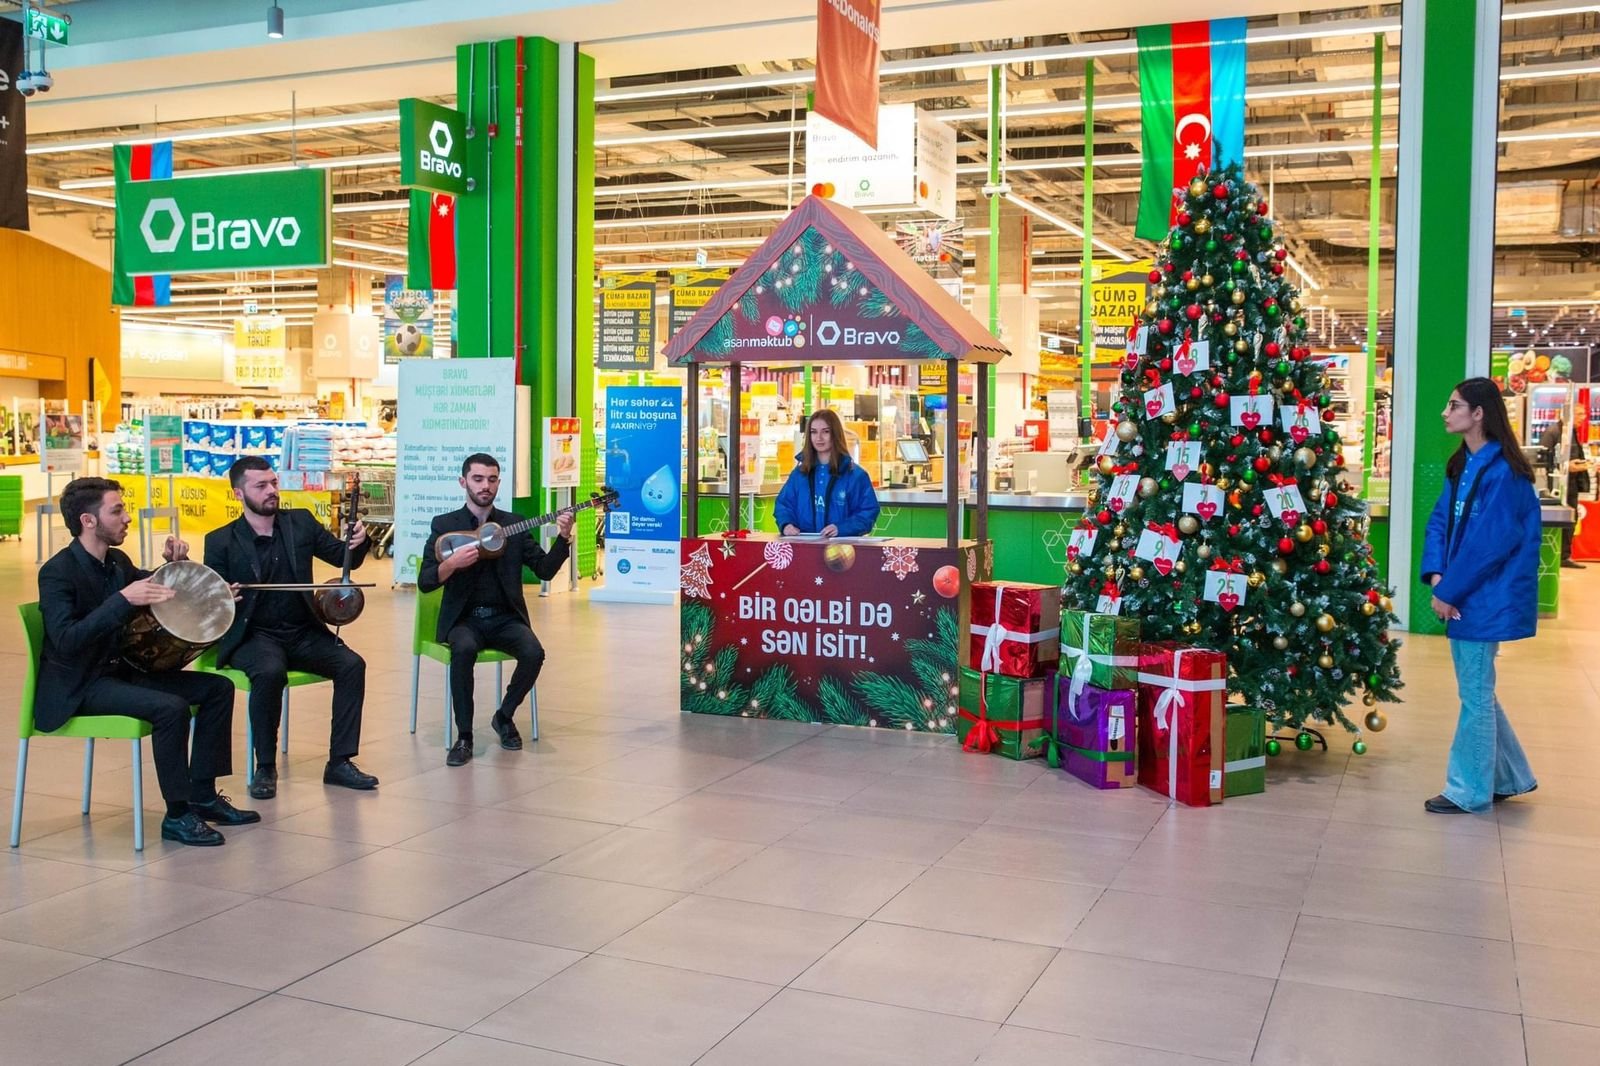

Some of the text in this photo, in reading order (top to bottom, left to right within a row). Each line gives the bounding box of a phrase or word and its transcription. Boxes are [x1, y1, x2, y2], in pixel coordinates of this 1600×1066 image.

[420, 149, 463, 178] Bravo
[191, 212, 301, 251] Bravo
[1094, 286, 1137, 302] CÜMƏ
[723, 336, 793, 348] asanməktub
[843, 327, 900, 345] Bravo
[442, 368, 468, 380] BRAVO
[415, 384, 449, 398] MÜŞTƏRİ
[433, 402, 477, 413] HƏR ZAMAN
[610, 397, 630, 407] Hər
[630, 397, 660, 407] səhər
[610, 409, 677, 422] litr su boşuna
[180, 488, 207, 500] XÜSUSİ
[180, 503, 207, 517] TƏKLİF
[1154, 540, 1164, 556] 9
[738, 591, 893, 628] BİR QƏLBİ DƏ
[761, 627, 866, 659] SƏN İSİT!
